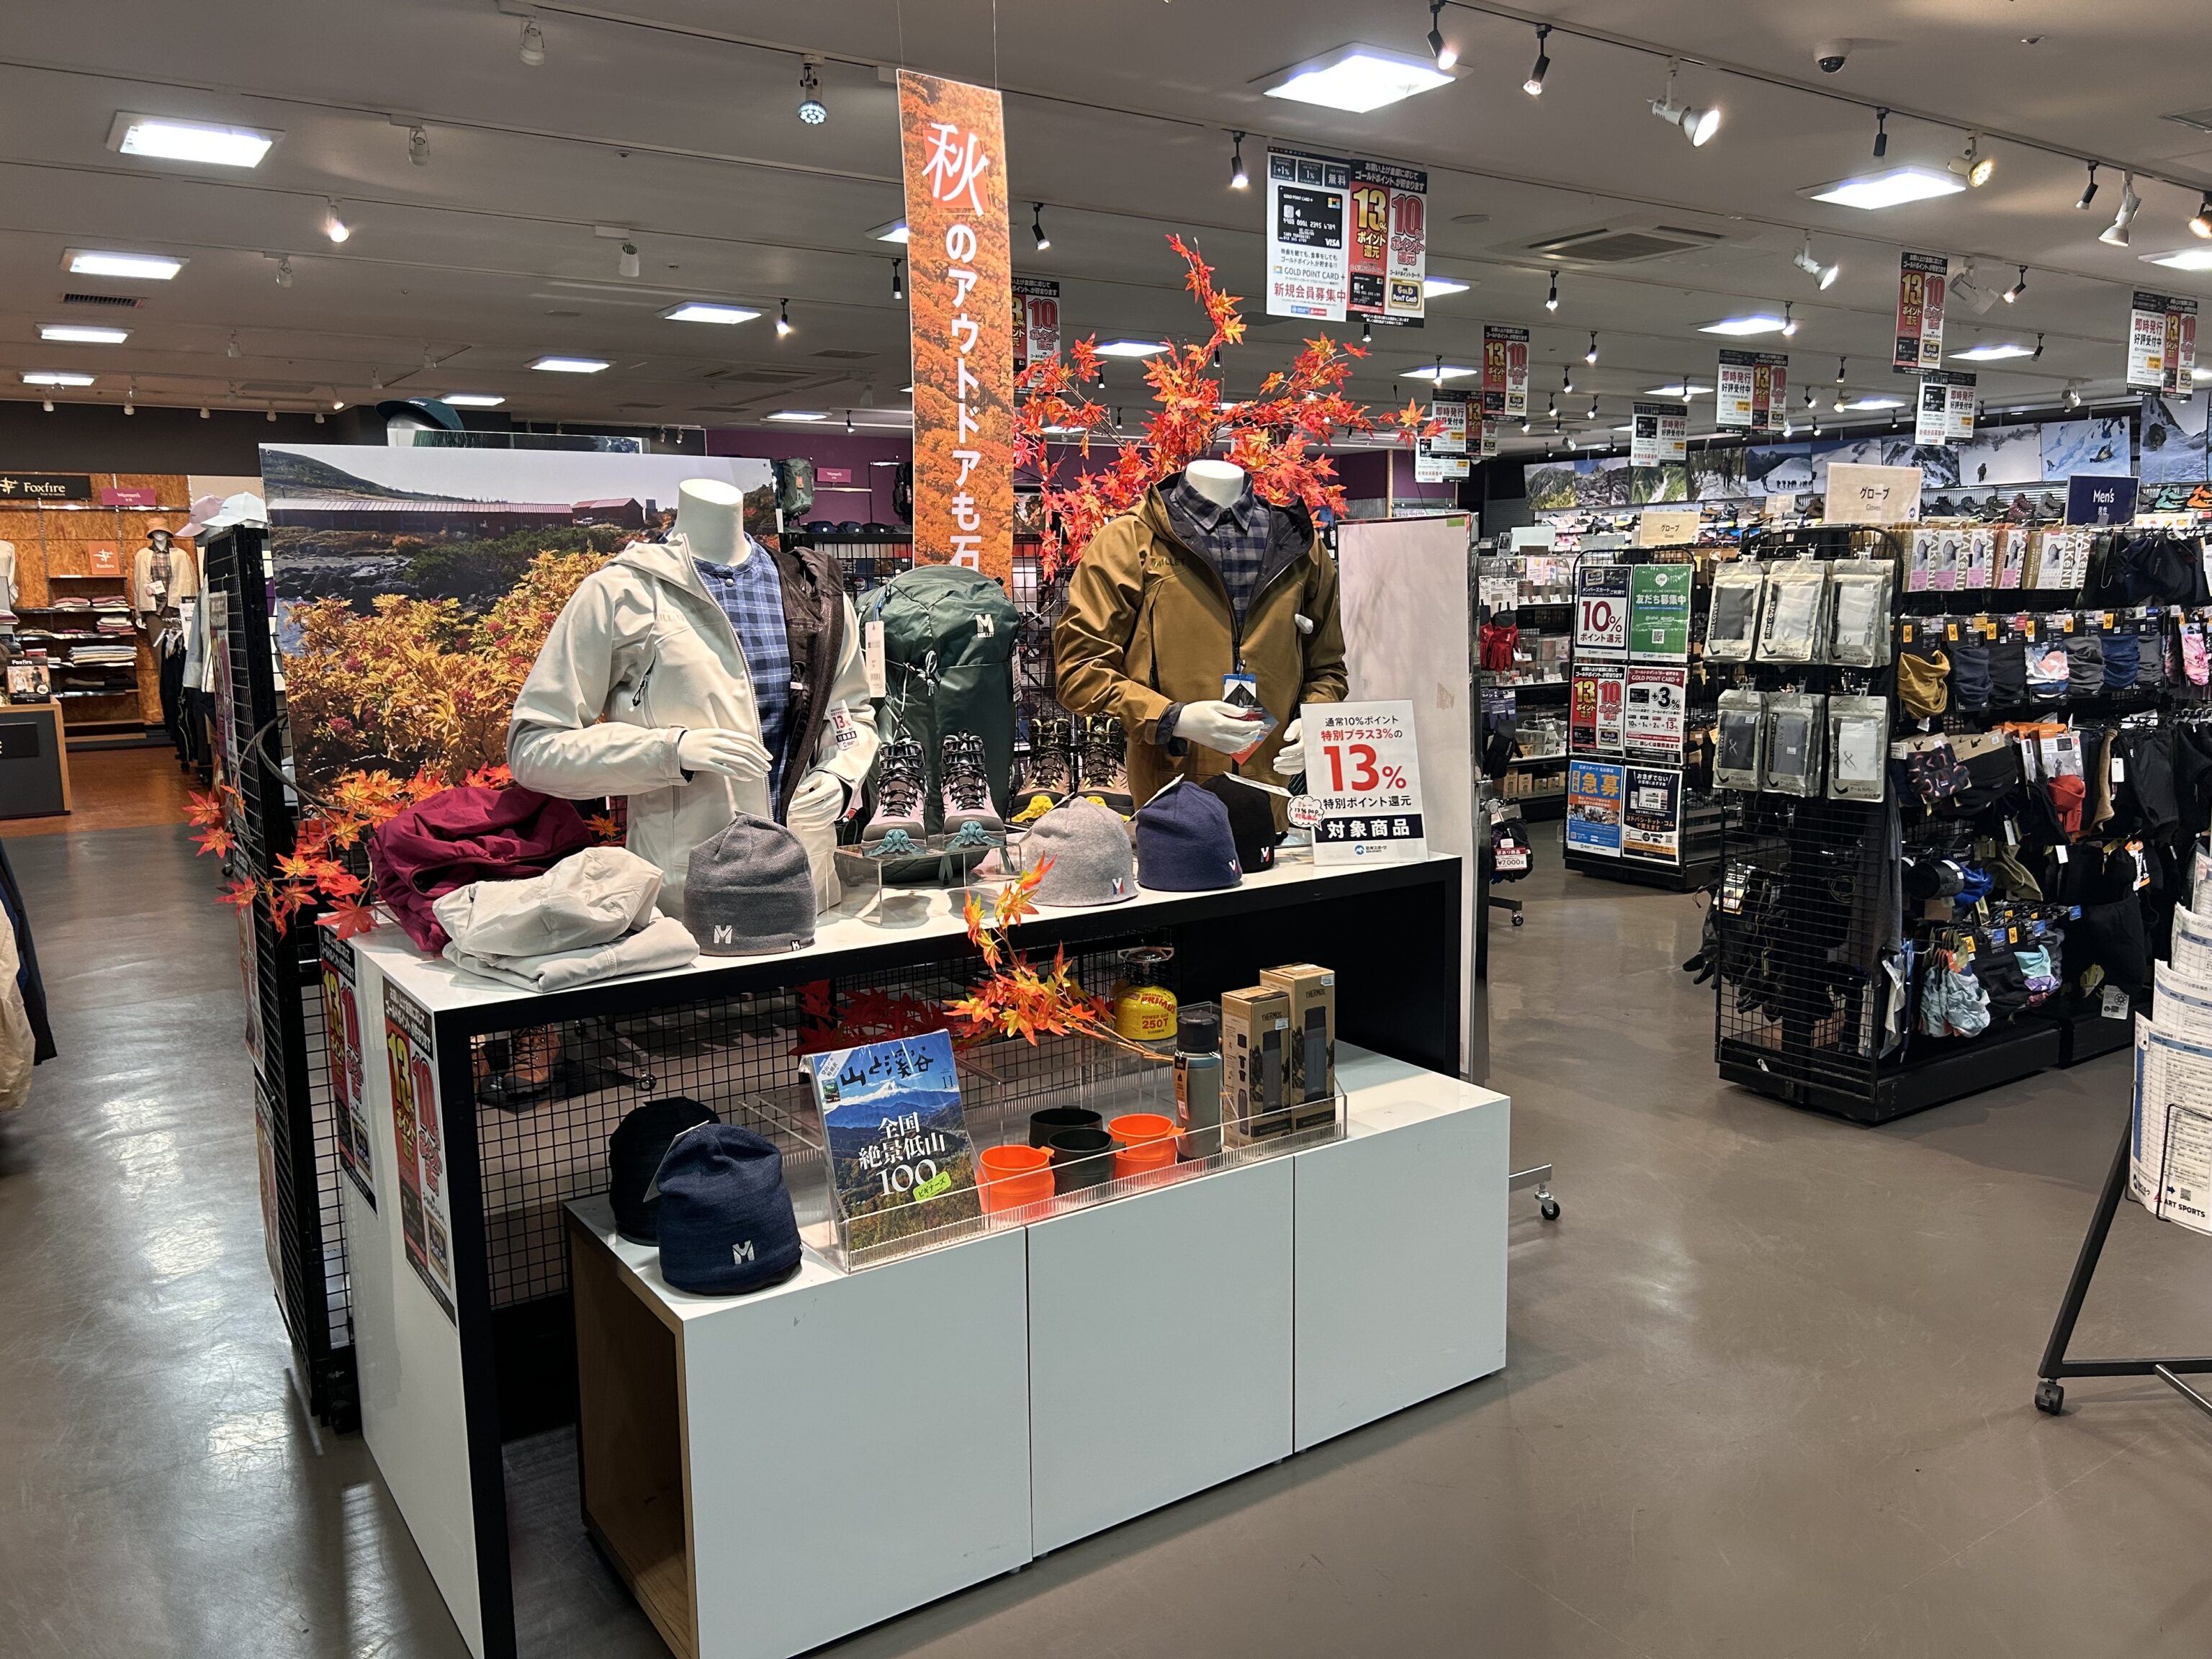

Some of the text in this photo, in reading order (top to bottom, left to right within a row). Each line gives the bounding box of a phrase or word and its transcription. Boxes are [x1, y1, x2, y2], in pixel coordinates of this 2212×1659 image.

[1328, 173, 1346, 186] 無料
[1353, 187, 1387, 233] 13%
[1392, 194, 1424, 240] 10%
[1325, 238, 1340, 247] VISA
[1357, 231, 1386, 246] ポイント
[1391, 237, 1424, 253] ポイント
[1364, 245, 1380, 258] 還元
[1398, 251, 1416, 266] 還元
[1285, 267, 1301, 276] GOLD
[1303, 269, 1321, 278] POINT
[1322, 271, 1339, 280] CARD
[1274, 282, 1346, 302] 新規会員募集中
[1398, 286, 1413, 295] GOLD
[1902, 307, 1922, 317] ポイント
[2135, 318, 2163, 335] 即時発行
[1030, 329, 1059, 343] ポイント
[2134, 334, 2162, 347] 好評受付中
[1722, 370, 1751, 385] 即時発行
[1722, 383, 1750, 394] 好評受付中
[1951, 390, 1974, 401] 即時発行
[1951, 401, 1972, 410] 好評受付中
[1436, 407, 1465, 418] 即時発行
[1662, 420, 1686, 430] 即時発行
[24, 482, 66, 493] Foxfire
[1859, 487, 1891, 500] グローブ
[2092, 487, 2115, 503] Men's
[1866, 503, 1882, 512] Gloves
[2098, 506, 2108, 516] 男性
[1660, 523, 1681, 533] グローブ
[1636, 594, 1686, 605] 友だち募集中
[1582, 601, 1622, 633] 10%
[1581, 633, 1622, 643] ポイント還元
[1325, 715, 1398, 727] 通常10%ポイント
[1321, 728, 1403, 742] 特別プラス3%の
[1323, 744, 1406, 792] 13%
[1637, 773, 1668, 782] お急ぎでない
[1581, 773, 1619, 797] 急募
[1323, 795, 1411, 809] 特別ポイント還元
[1626, 815, 1674, 827] ヨドバシ・ドット・コム
[1327, 818, 1410, 839] 対象商品
[1305, 989, 1326, 999] THERMOS
[1141, 996, 1176, 1014] PRIMUS
[1262, 1011, 1282, 1021] THERMOS
[1142, 1017, 1169, 1029] 250T
[878, 1112, 921, 1140] 全国
[858, 1132, 946, 1170] 絶景低山
[876, 1159, 937, 1197] 100
[918, 1177, 946, 1199] ビギナーズ
[2164, 1198, 2206, 1218] ART SPORTS
